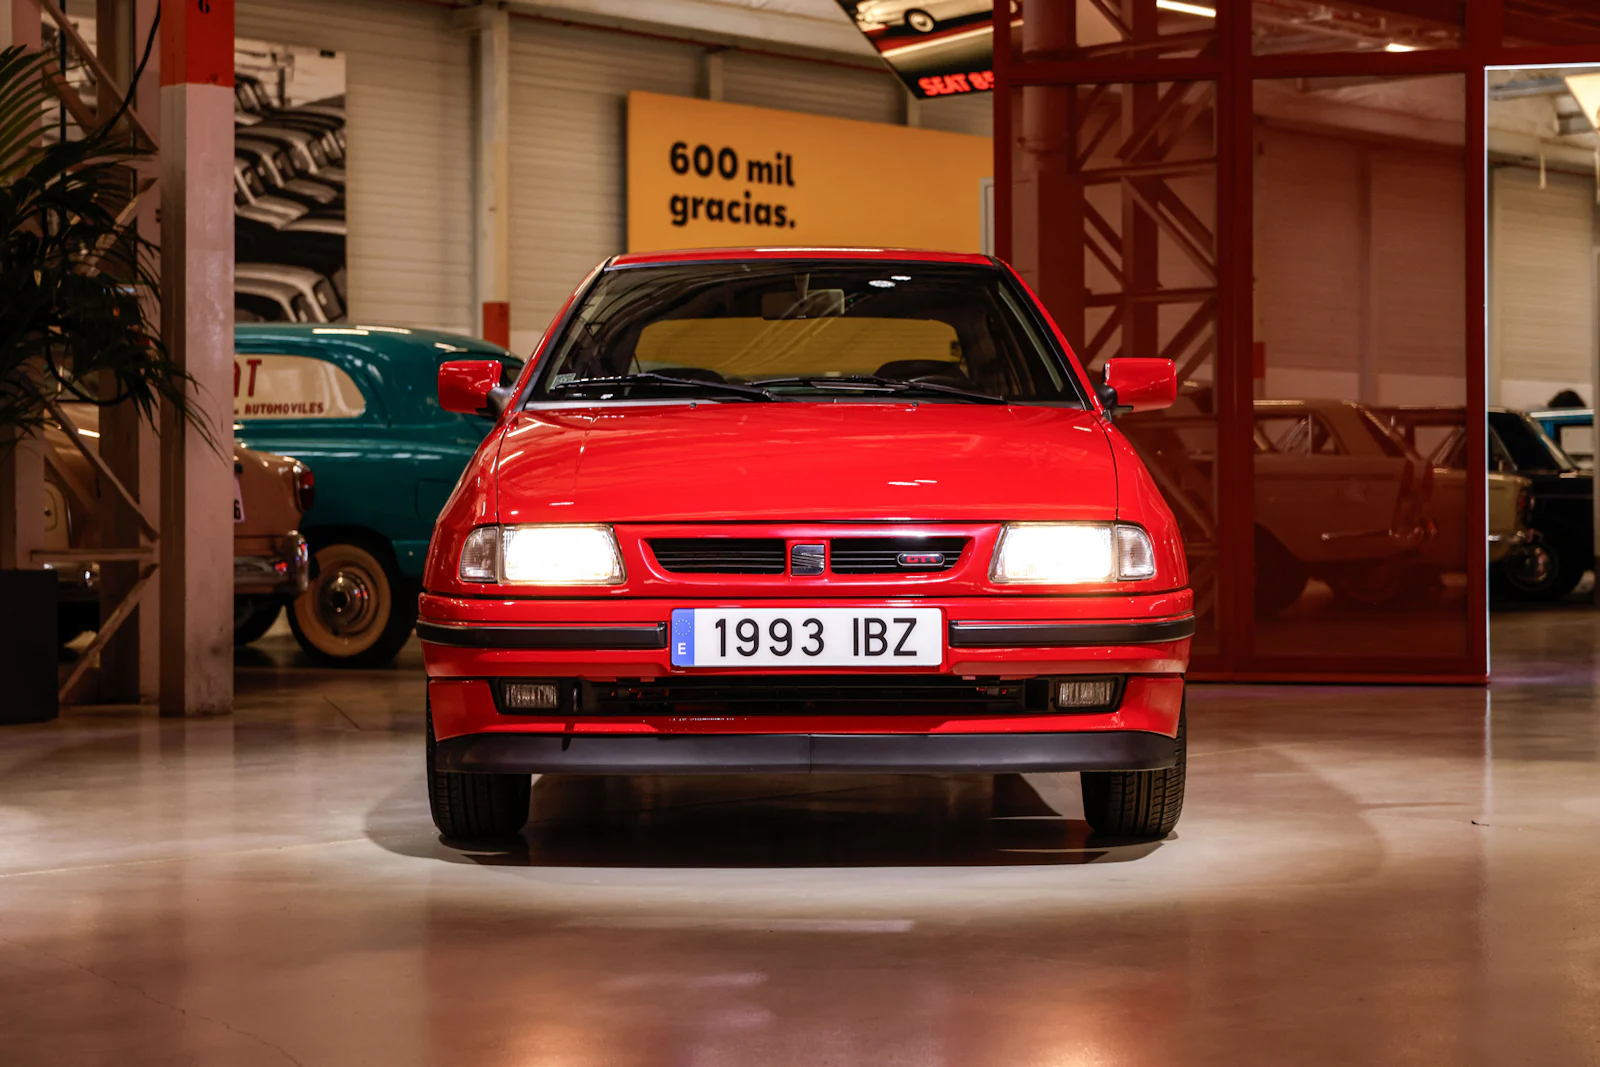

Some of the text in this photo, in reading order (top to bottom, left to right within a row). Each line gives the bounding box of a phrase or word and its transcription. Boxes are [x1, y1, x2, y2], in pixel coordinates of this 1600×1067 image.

[918, 72, 971, 97] SEAT
[669, 140, 795, 187] 600 mil
[669, 190, 796, 228] gracias.
[244, 402, 324, 415] AUTOMOVILES
[677, 617, 918, 657] E 1993 IBZ
